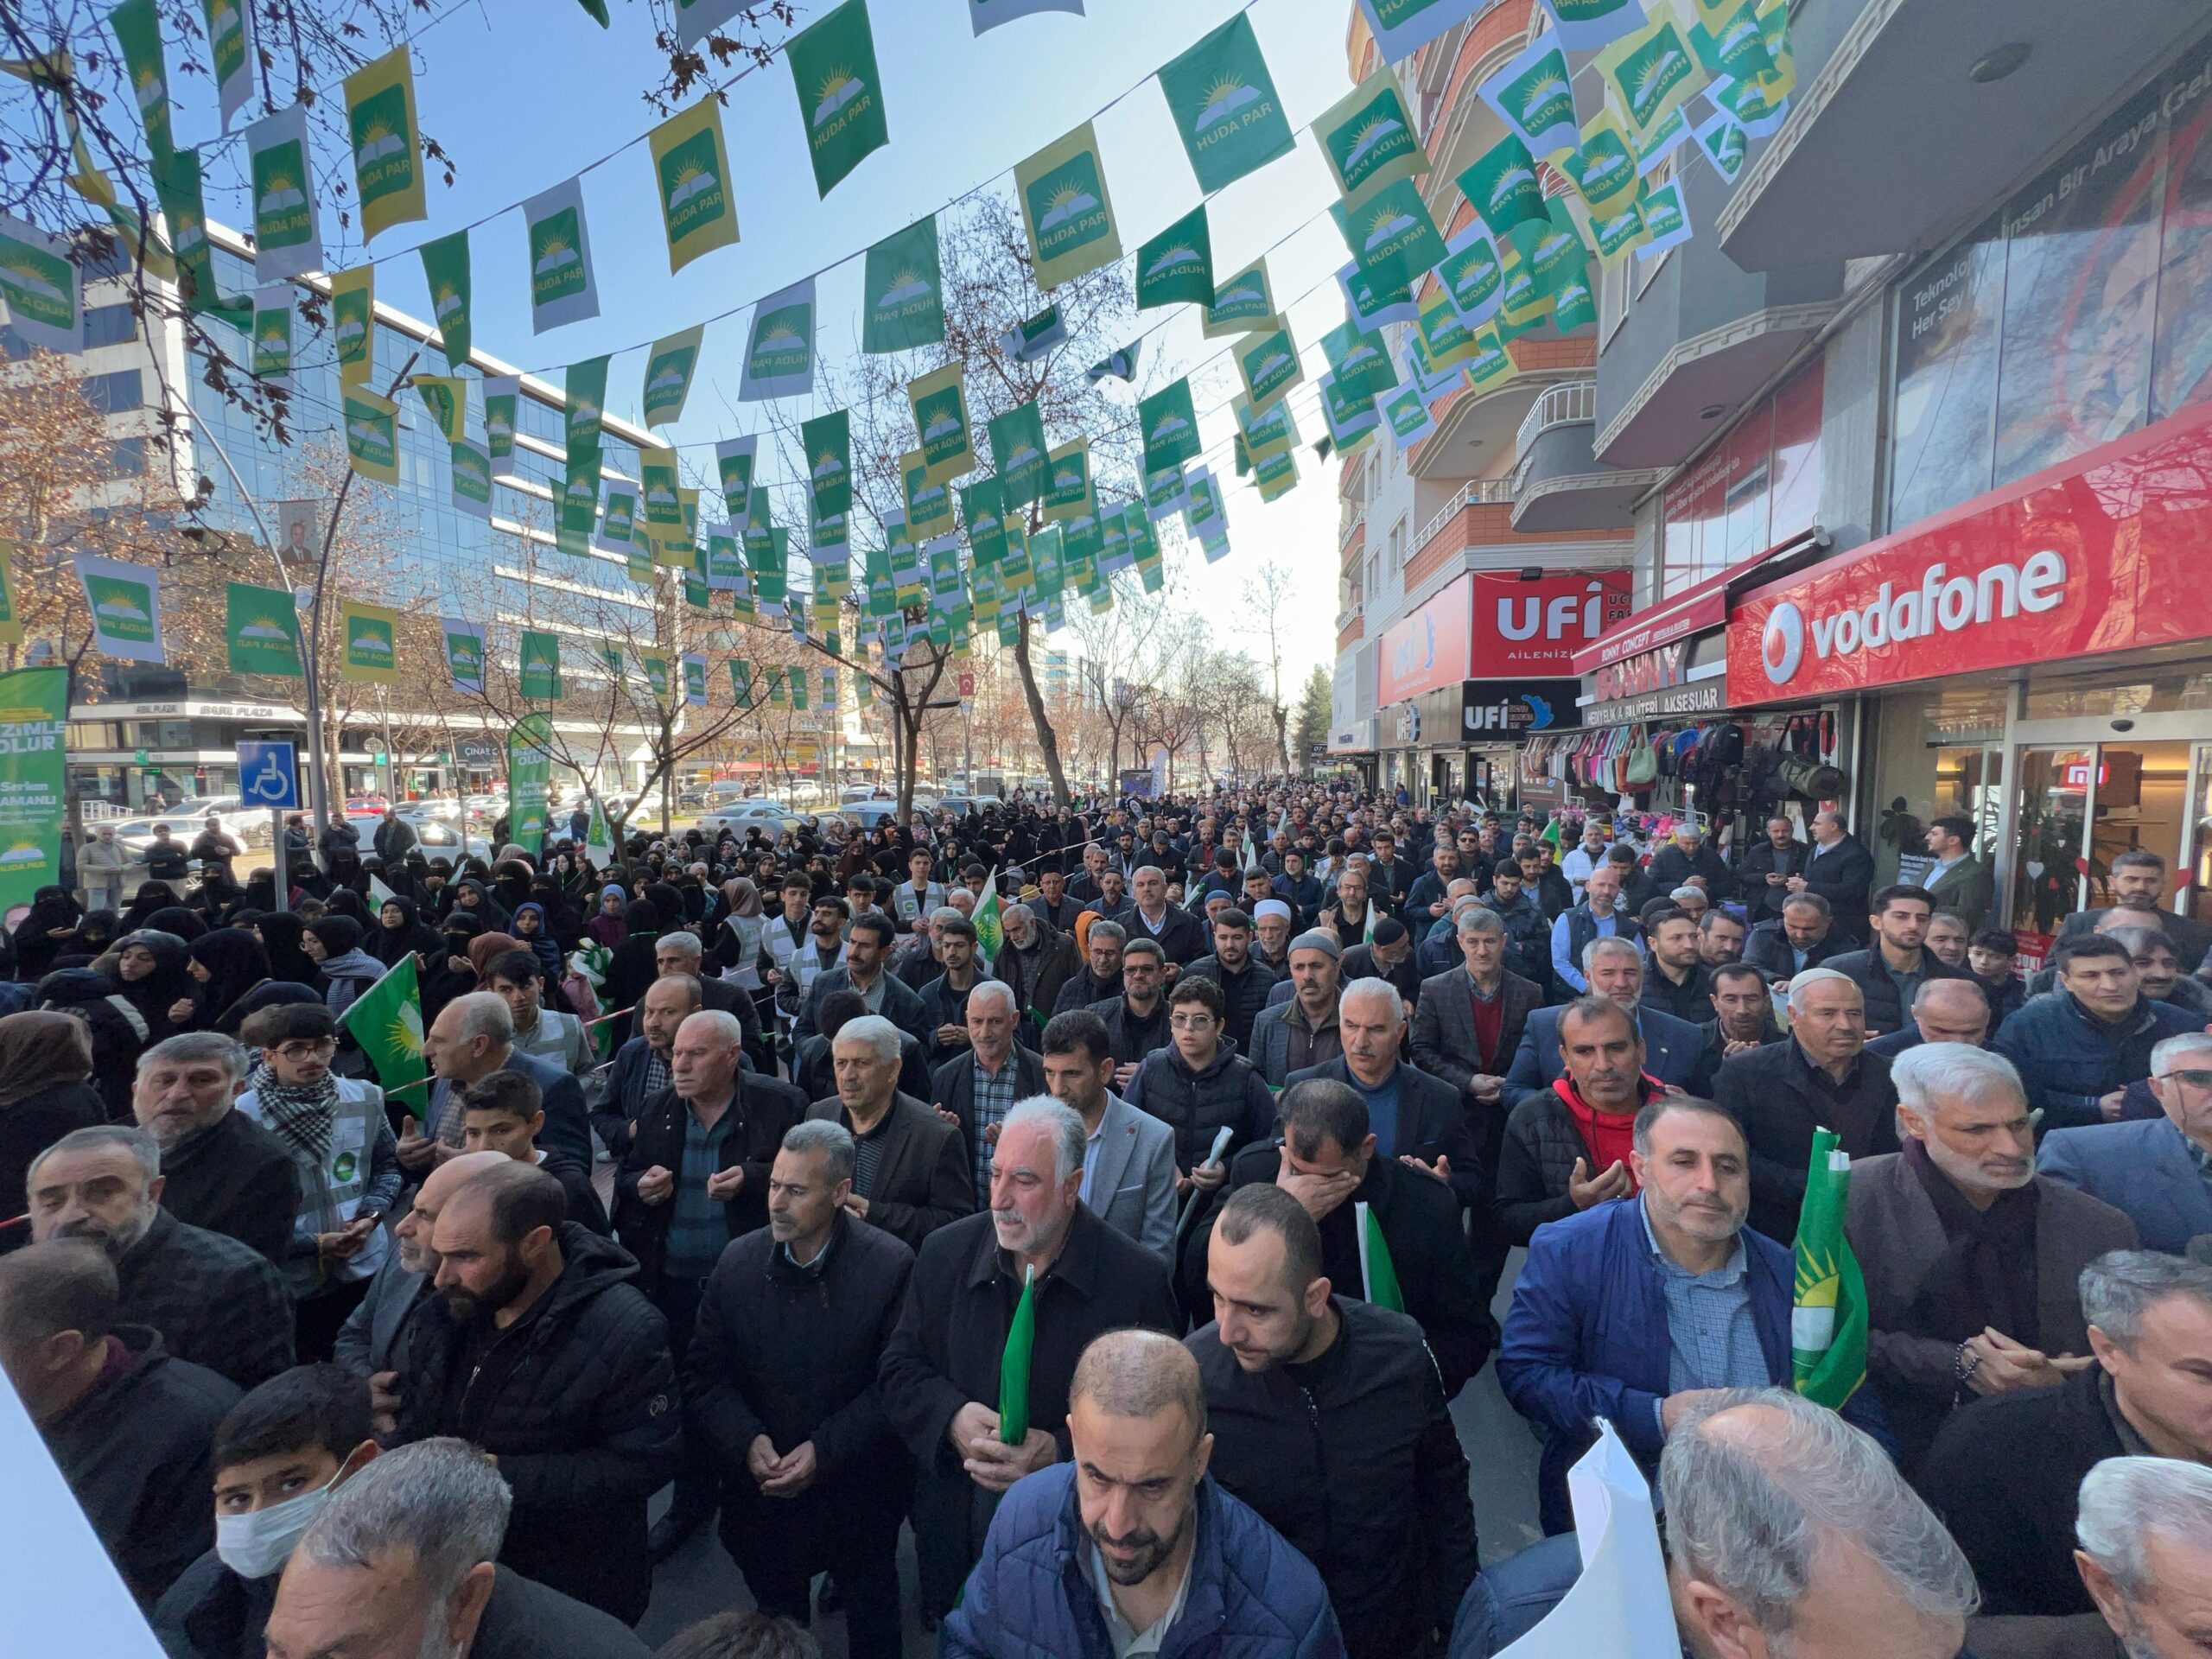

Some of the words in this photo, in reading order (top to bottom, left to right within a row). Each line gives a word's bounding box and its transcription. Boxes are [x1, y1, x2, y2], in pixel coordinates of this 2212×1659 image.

[848, 95, 872, 123] PAR
[1242, 102, 1272, 126] PAR
[386, 159, 410, 178] PAR
[699, 191, 722, 212] PAR
[290, 213, 310, 228] PAR
[1079, 210, 1106, 233] PAR
[1402, 226, 1427, 246] PAR
[563, 266, 584, 283] PAR
[1912, 310, 1937, 340] Her
[1938, 289, 1965, 323] Şey
[1368, 359, 1384, 371] PAR
[1811, 550, 2066, 658] vodafone
[1622, 630, 1650, 654] CONCEPT
[1508, 649, 1577, 659] AİLENİZİ
[1596, 641, 1683, 702] BONNY
[1664, 688, 1718, 713] AKSESUAR
